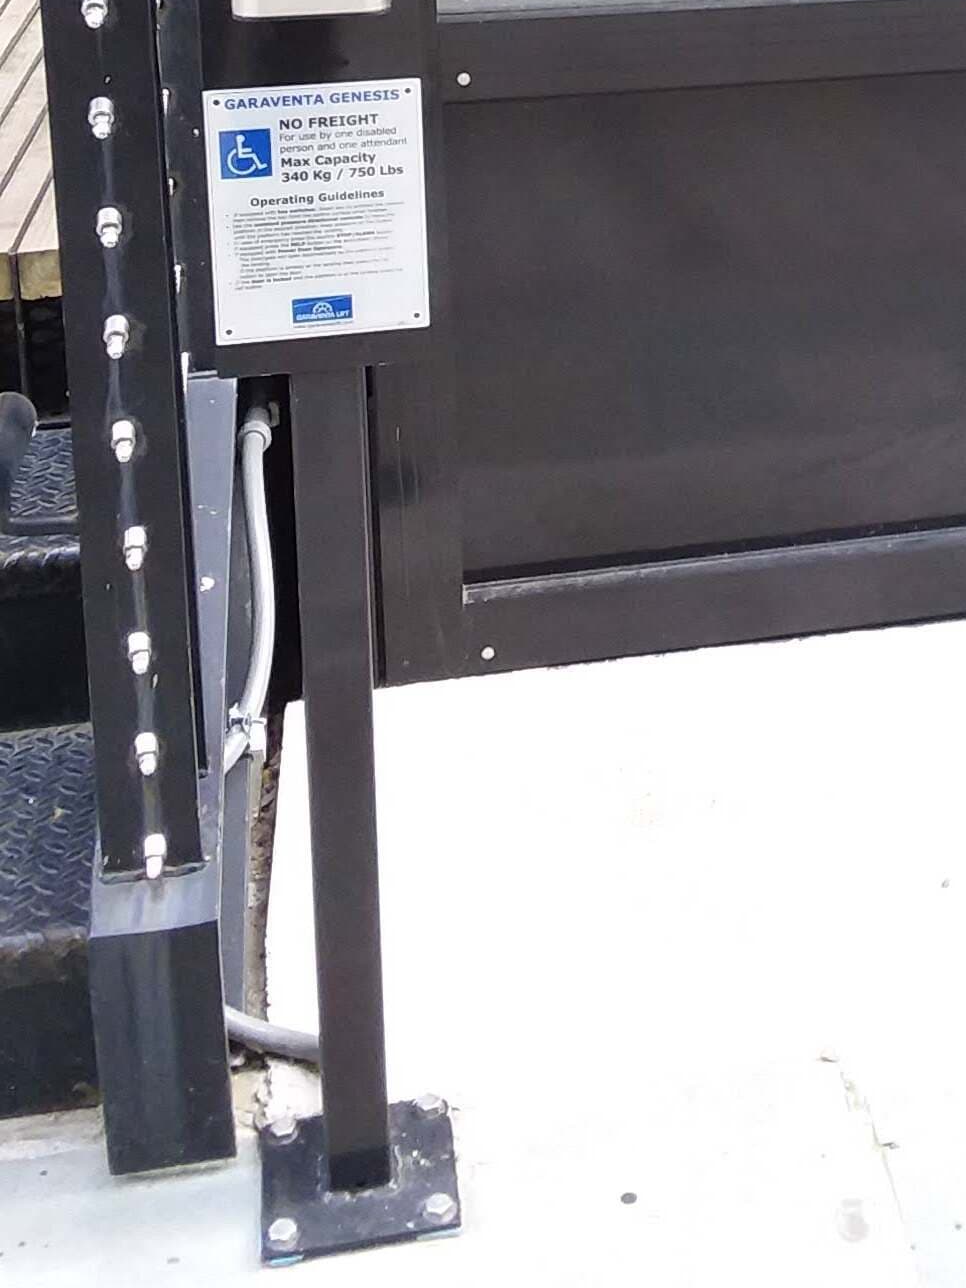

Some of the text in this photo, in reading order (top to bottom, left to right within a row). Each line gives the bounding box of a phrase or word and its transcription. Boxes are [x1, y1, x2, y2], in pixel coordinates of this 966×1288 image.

[223, 89, 400, 110] GARAVENTA GENESIS
[279, 113, 379, 131] NO FREIGHT
[279, 127, 397, 142] For use by one disabled
[280, 137, 408, 154] person and one attendant
[281, 151, 377, 168] Max Capacity
[281, 164, 405, 183] 340 Kg / 750 Lbs
[250, 189, 385, 208] Operating Guidelines
